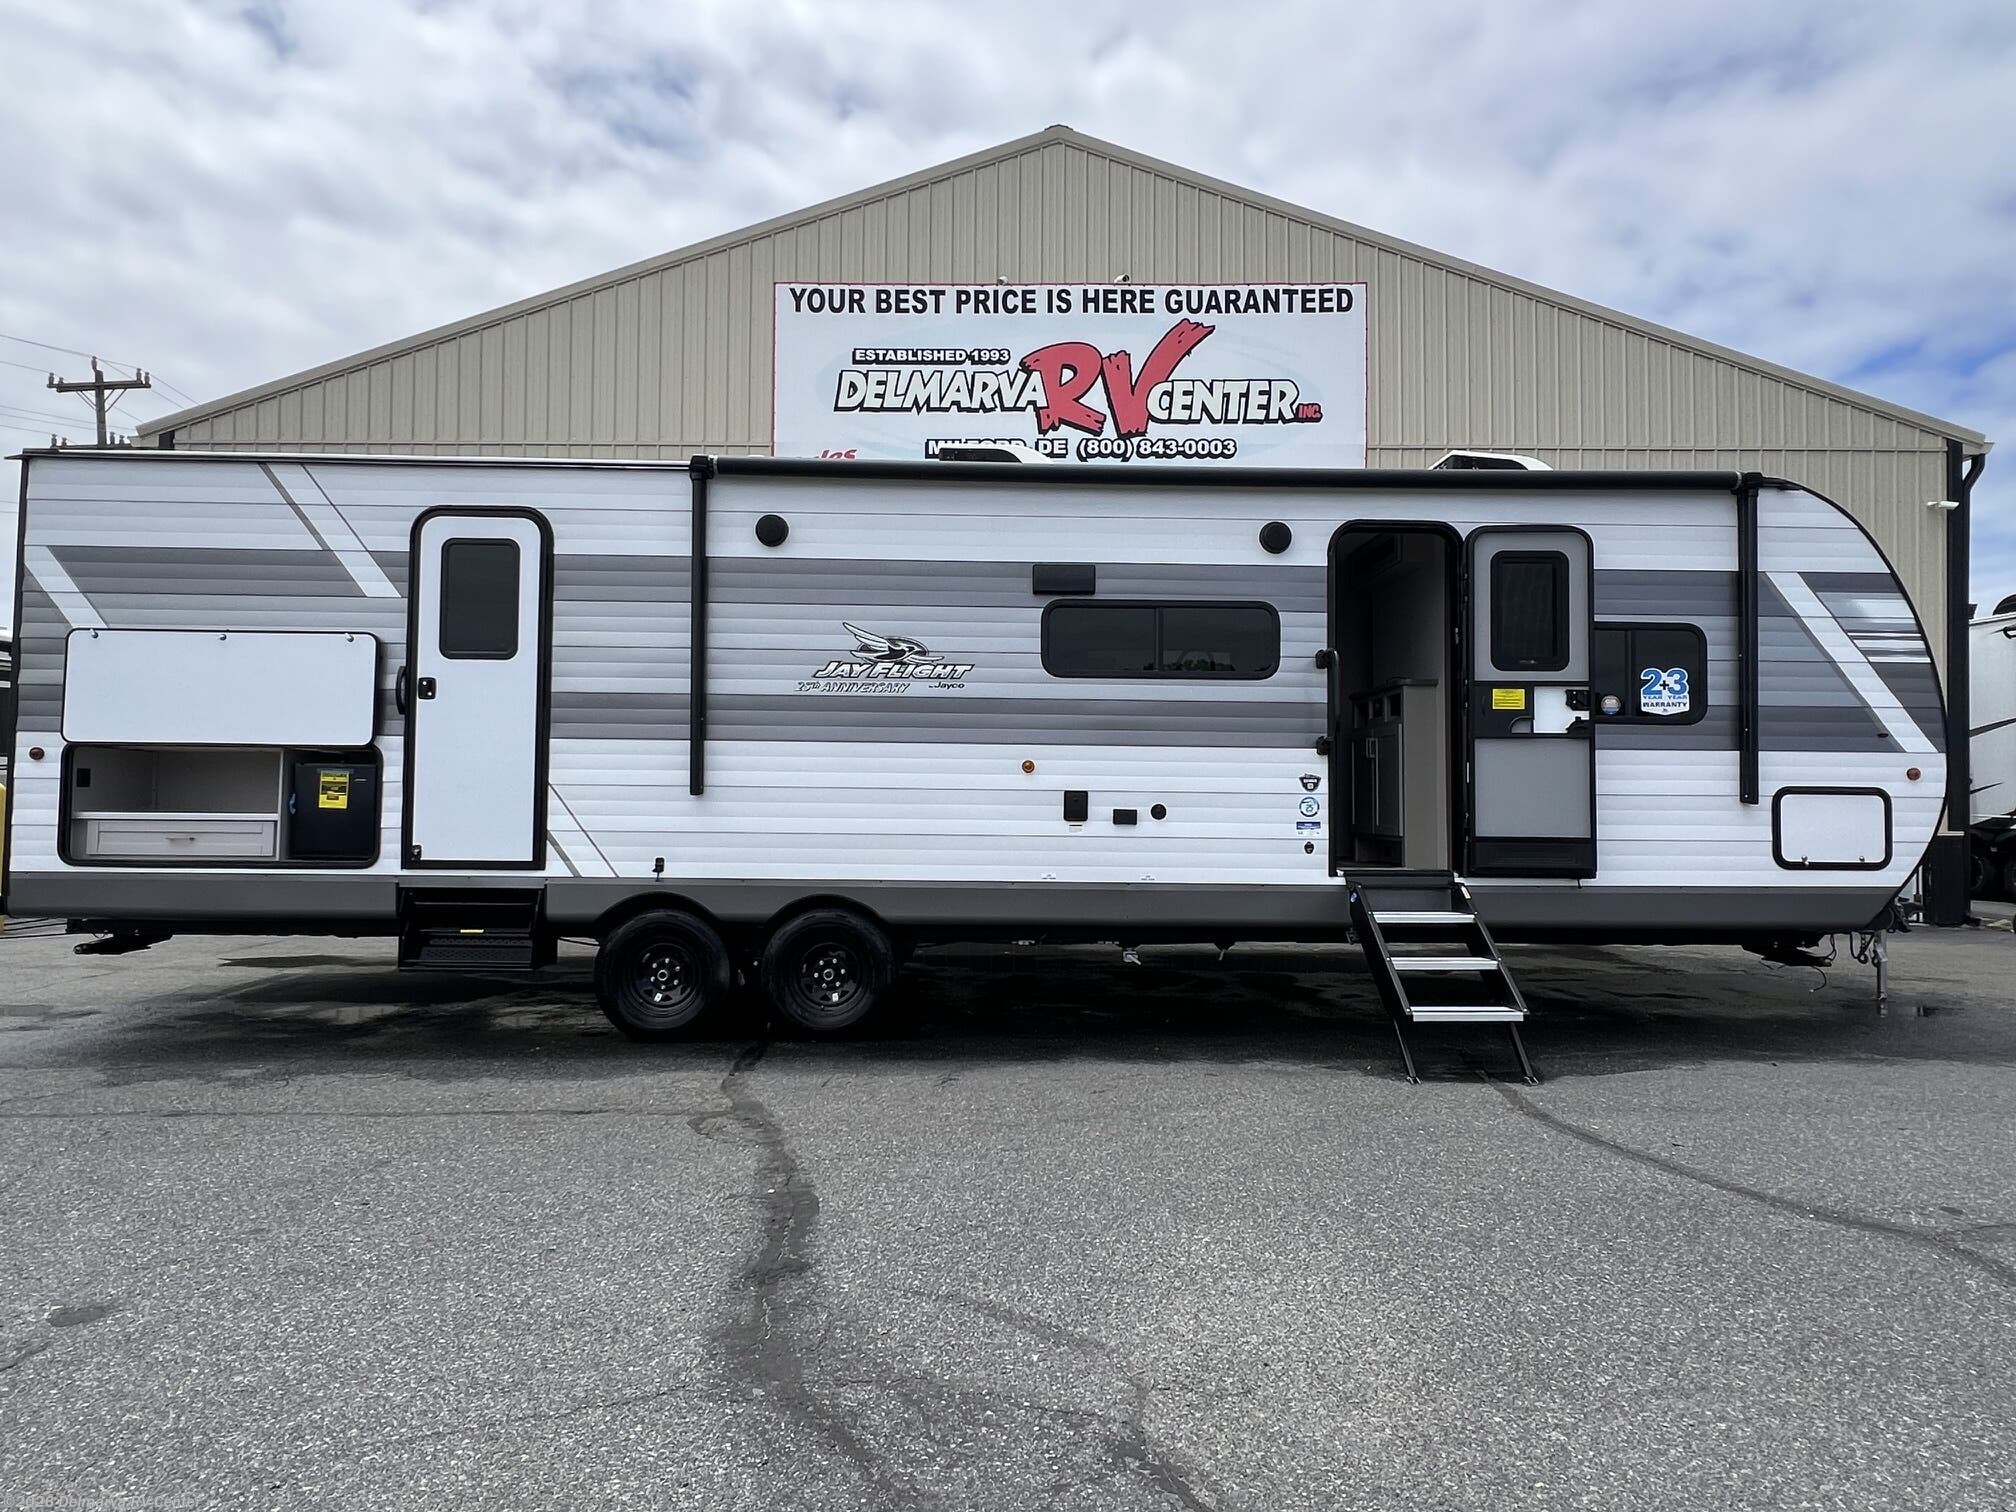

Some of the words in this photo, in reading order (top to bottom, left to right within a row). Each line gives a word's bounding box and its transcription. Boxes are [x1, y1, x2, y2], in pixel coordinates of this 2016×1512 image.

[789, 288, 866, 314] YOUR
[875, 288, 946, 314] BEST
[955, 288, 1037, 314] PRICE
[1046, 288, 1073, 314] IS
[1081, 288, 1155, 314] HERE
[1164, 288, 1354, 314] GUARANTEED
[853, 349, 968, 364] ESTABLISHED
[970, 349, 1011, 364] 1993
[834, 370, 1050, 413] DELMARVA
[1019, 318, 1216, 438] RV
[1147, 380, 1300, 424] CENTER
[1036, 439, 1068, 457] DE
[1079, 438, 1133, 460] (800)
[1137, 439, 1238, 458] 843-0003
[812, 661, 872, 679] JAY
[866, 662, 975, 680] FLIGHT
[820, 681, 912, 694] ANNIVERSARY
[934, 681, 966, 690] Jayco
